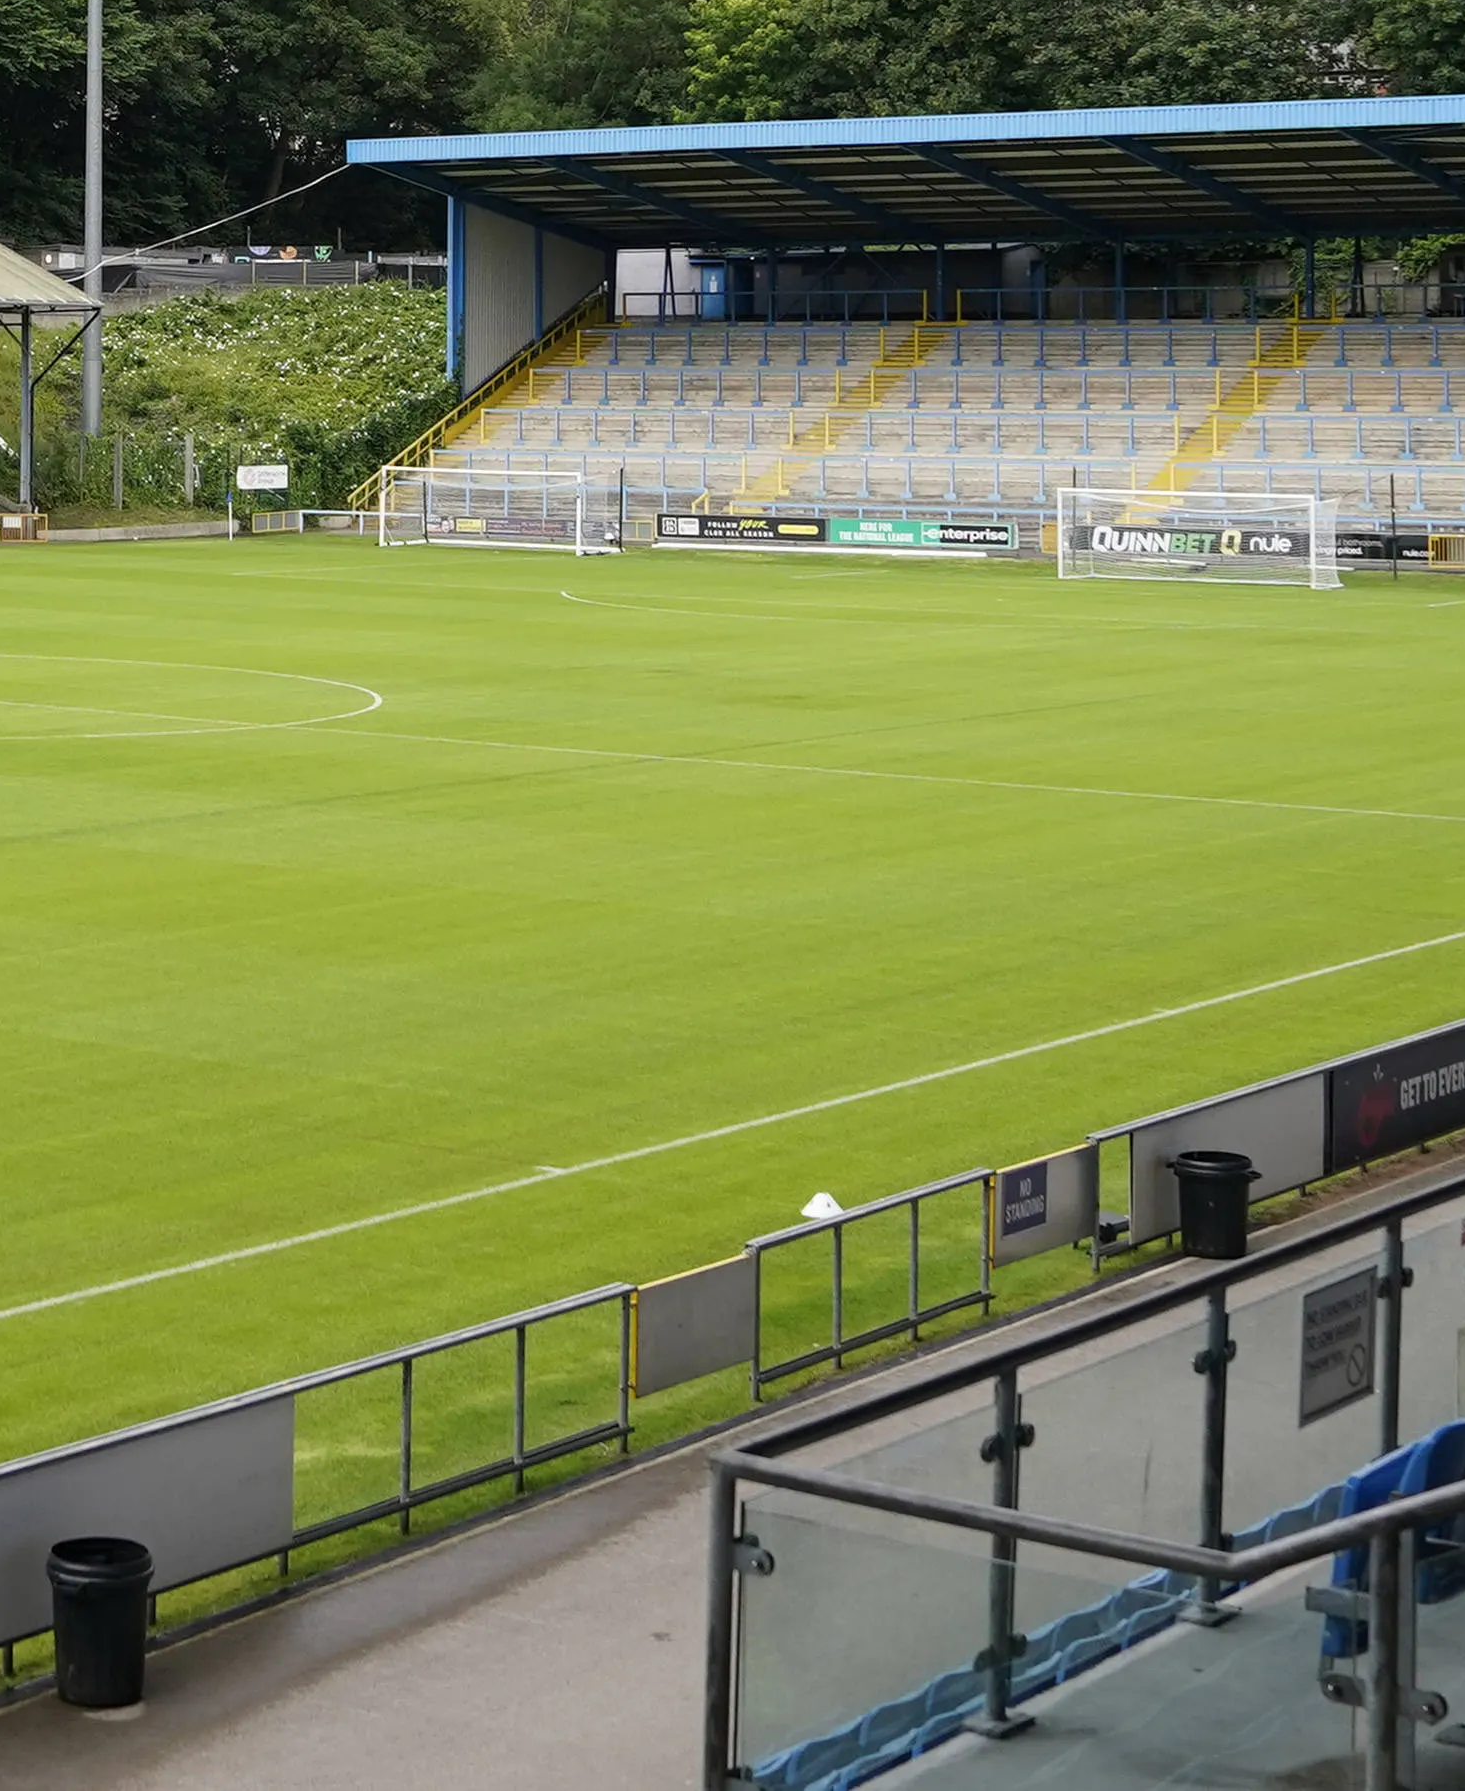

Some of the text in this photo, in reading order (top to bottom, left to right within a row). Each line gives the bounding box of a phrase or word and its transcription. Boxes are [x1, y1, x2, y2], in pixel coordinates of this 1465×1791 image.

[926, 528, 1008, 542] enterprise
[1092, 526, 1216, 554] QUINNBET
[1250, 534, 1292, 552] nuie
[1400, 1076, 1422, 1110] GET
[1422, 1070, 1437, 1102] TO
[1019, 1177, 1031, 1198] NO
[1005, 1194, 1044, 1224] STANDING
